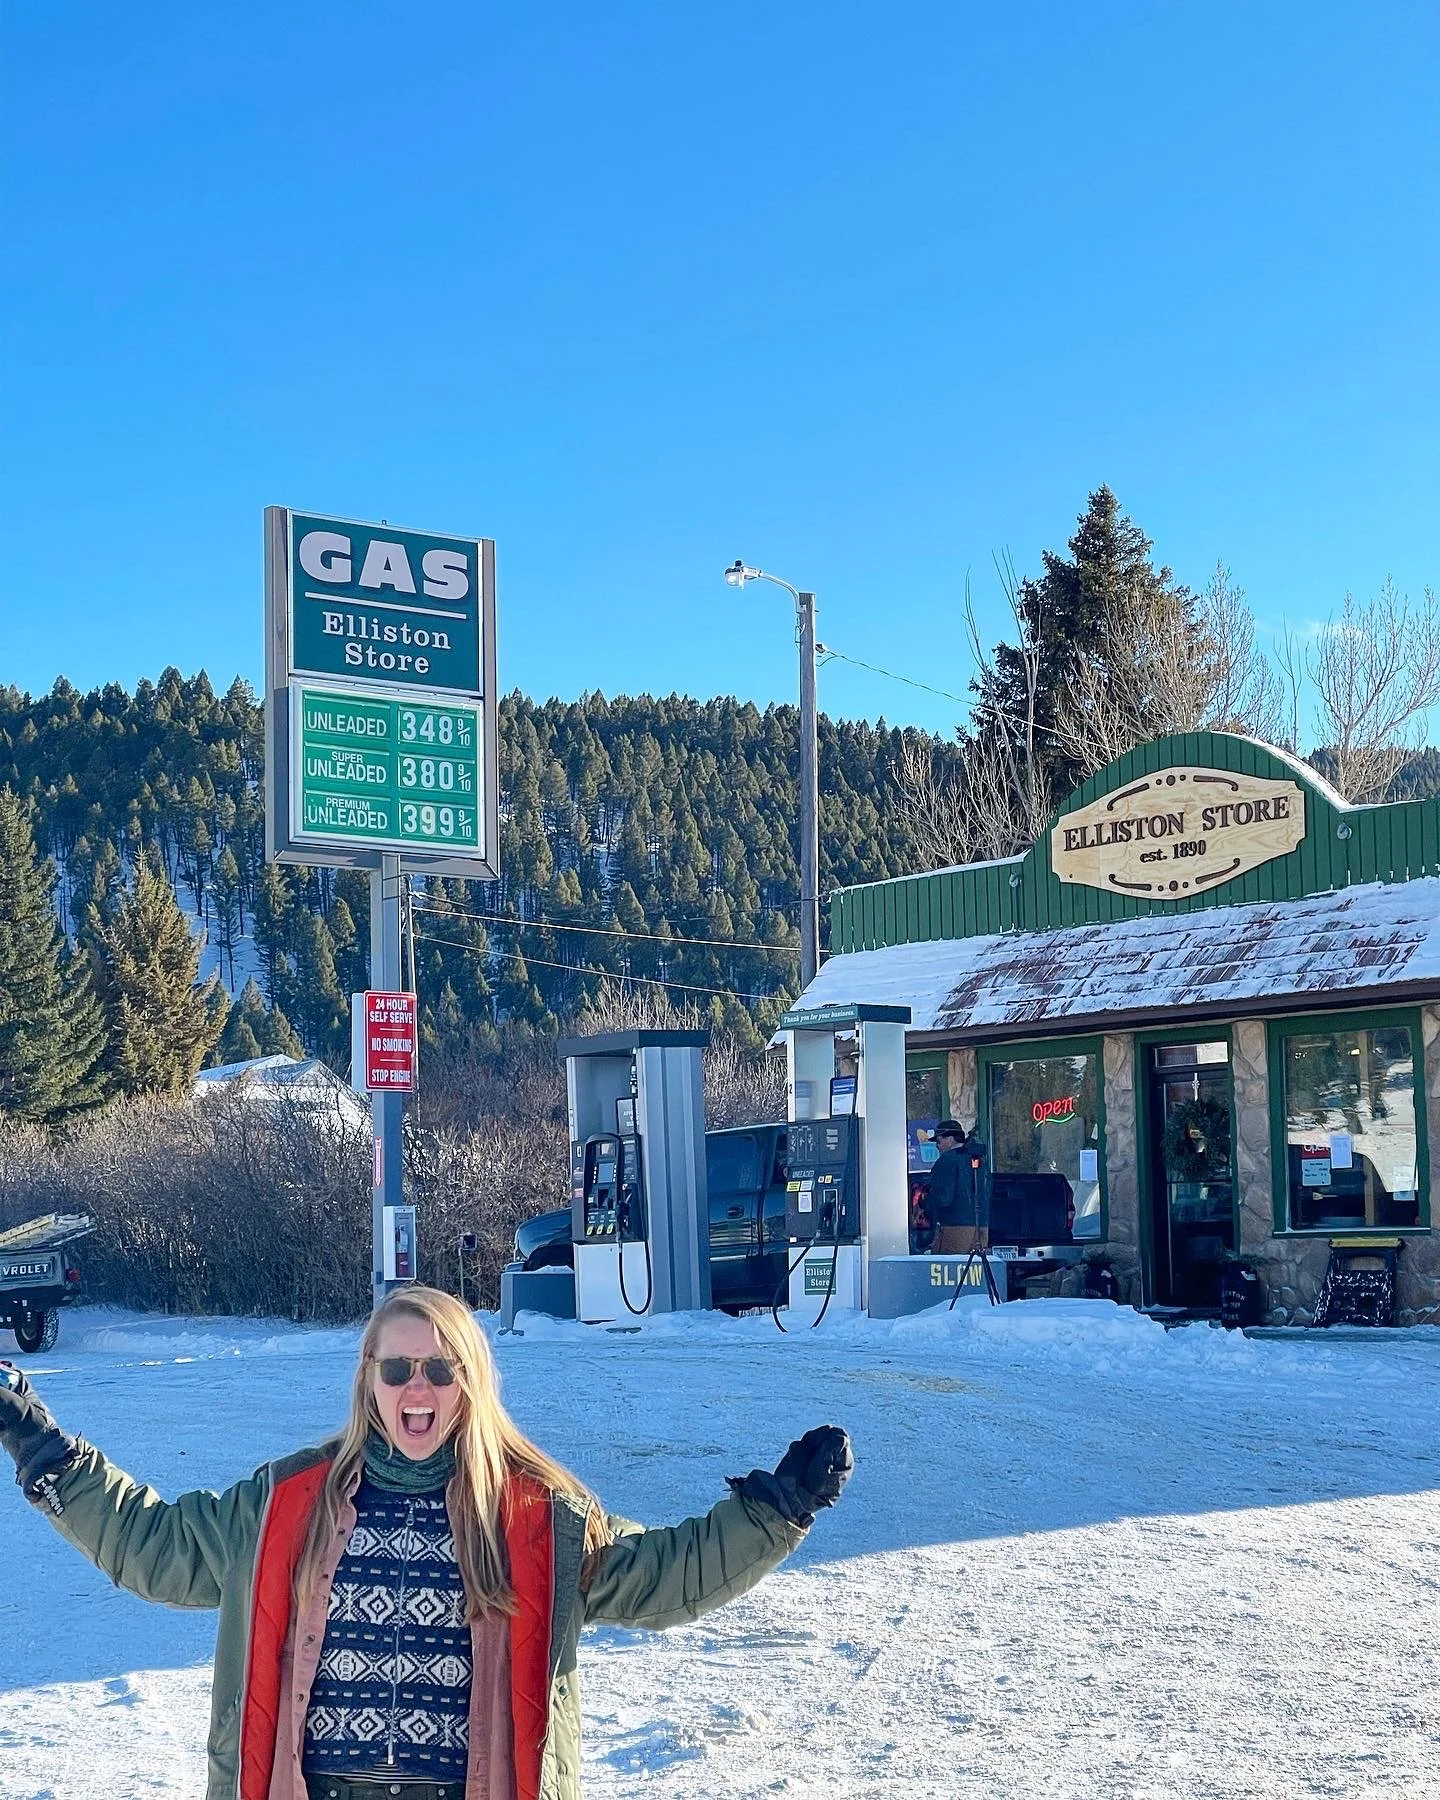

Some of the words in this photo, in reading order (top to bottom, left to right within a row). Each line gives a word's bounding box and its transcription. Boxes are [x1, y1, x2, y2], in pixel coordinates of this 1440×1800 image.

[299, 531, 469, 600] GAS
[322, 611, 451, 650] Elliston
[345, 642, 429, 674] Store
[307, 711, 387, 737] UNLEADED
[402, 711, 453, 745] 348
[331, 751, 363, 763] SUPER
[307, 758, 387, 784] UNLEADED
[402, 757, 453, 790] 380
[326, 797, 370, 811] PREMIUM
[307, 804, 388, 830] UNLEADED
[403, 804, 454, 836] 399
[1063, 811, 1185, 852] ELLISTON
[1202, 796, 1290, 832] STORE
[1139, 848, 1167, 863] est.
[1172, 839, 1207, 860] 1890
[375, 999, 385, 1009] 24
[386, 999, 408, 1011] HOUR
[369, 1011, 389, 1022] SELF
[389, 1012, 413, 1024] SERVE
[783, 1014, 799, 1024] Thank
[800, 1014, 810, 1022] you
[819, 1012, 831, 1021] your
[371, 1038, 381, 1051] NO
[382, 1038, 412, 1053] SMOKING
[371, 1069, 389, 1082] STOP
[390, 1070, 410, 1082] ENGINE
[0, 1264, 48, 1276] VROLET
[806, 1267, 832, 1277] Ellisto
[930, 1263, 983, 1286] SLOW
[810, 1278, 831, 1287] Store
